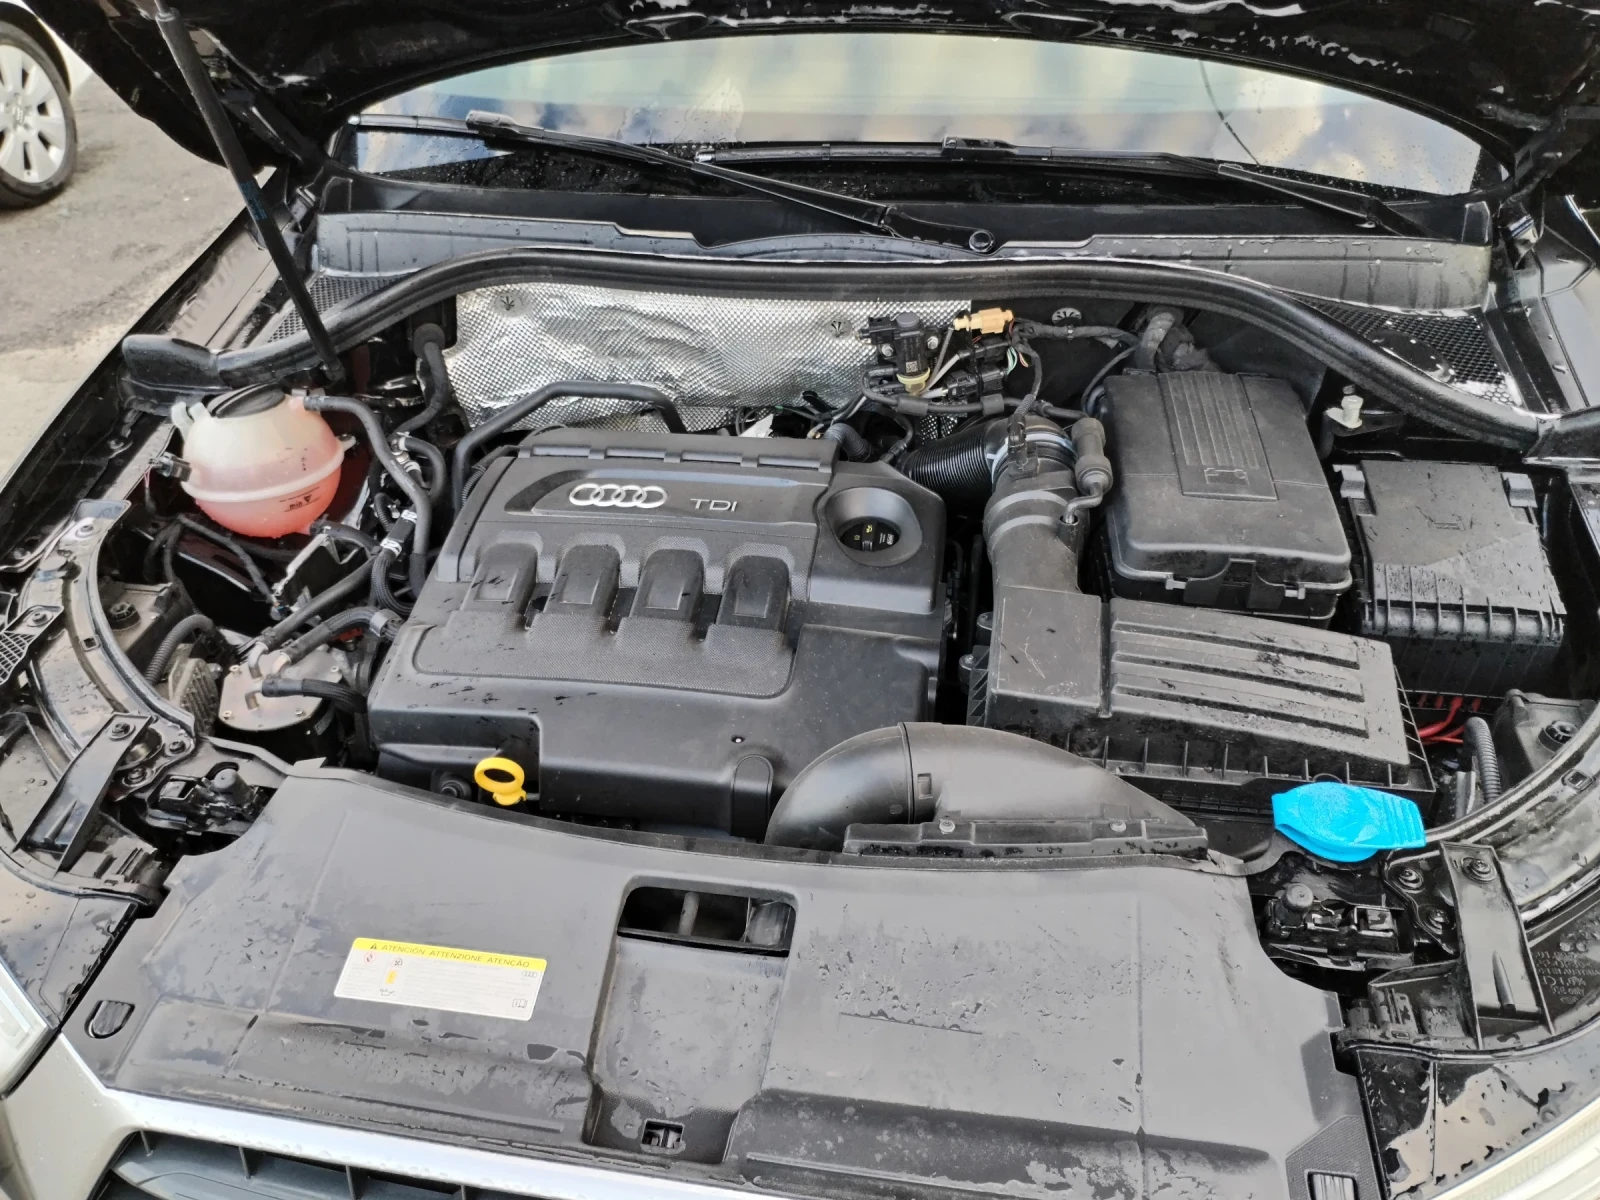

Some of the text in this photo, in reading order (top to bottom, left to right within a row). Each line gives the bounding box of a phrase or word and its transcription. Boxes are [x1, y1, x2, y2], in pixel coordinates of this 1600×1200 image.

[690, 498, 737, 512] TDI
[382, 944, 426, 955] ATENCIÓN
[429, 950, 483, 961] ATTENZIONE
